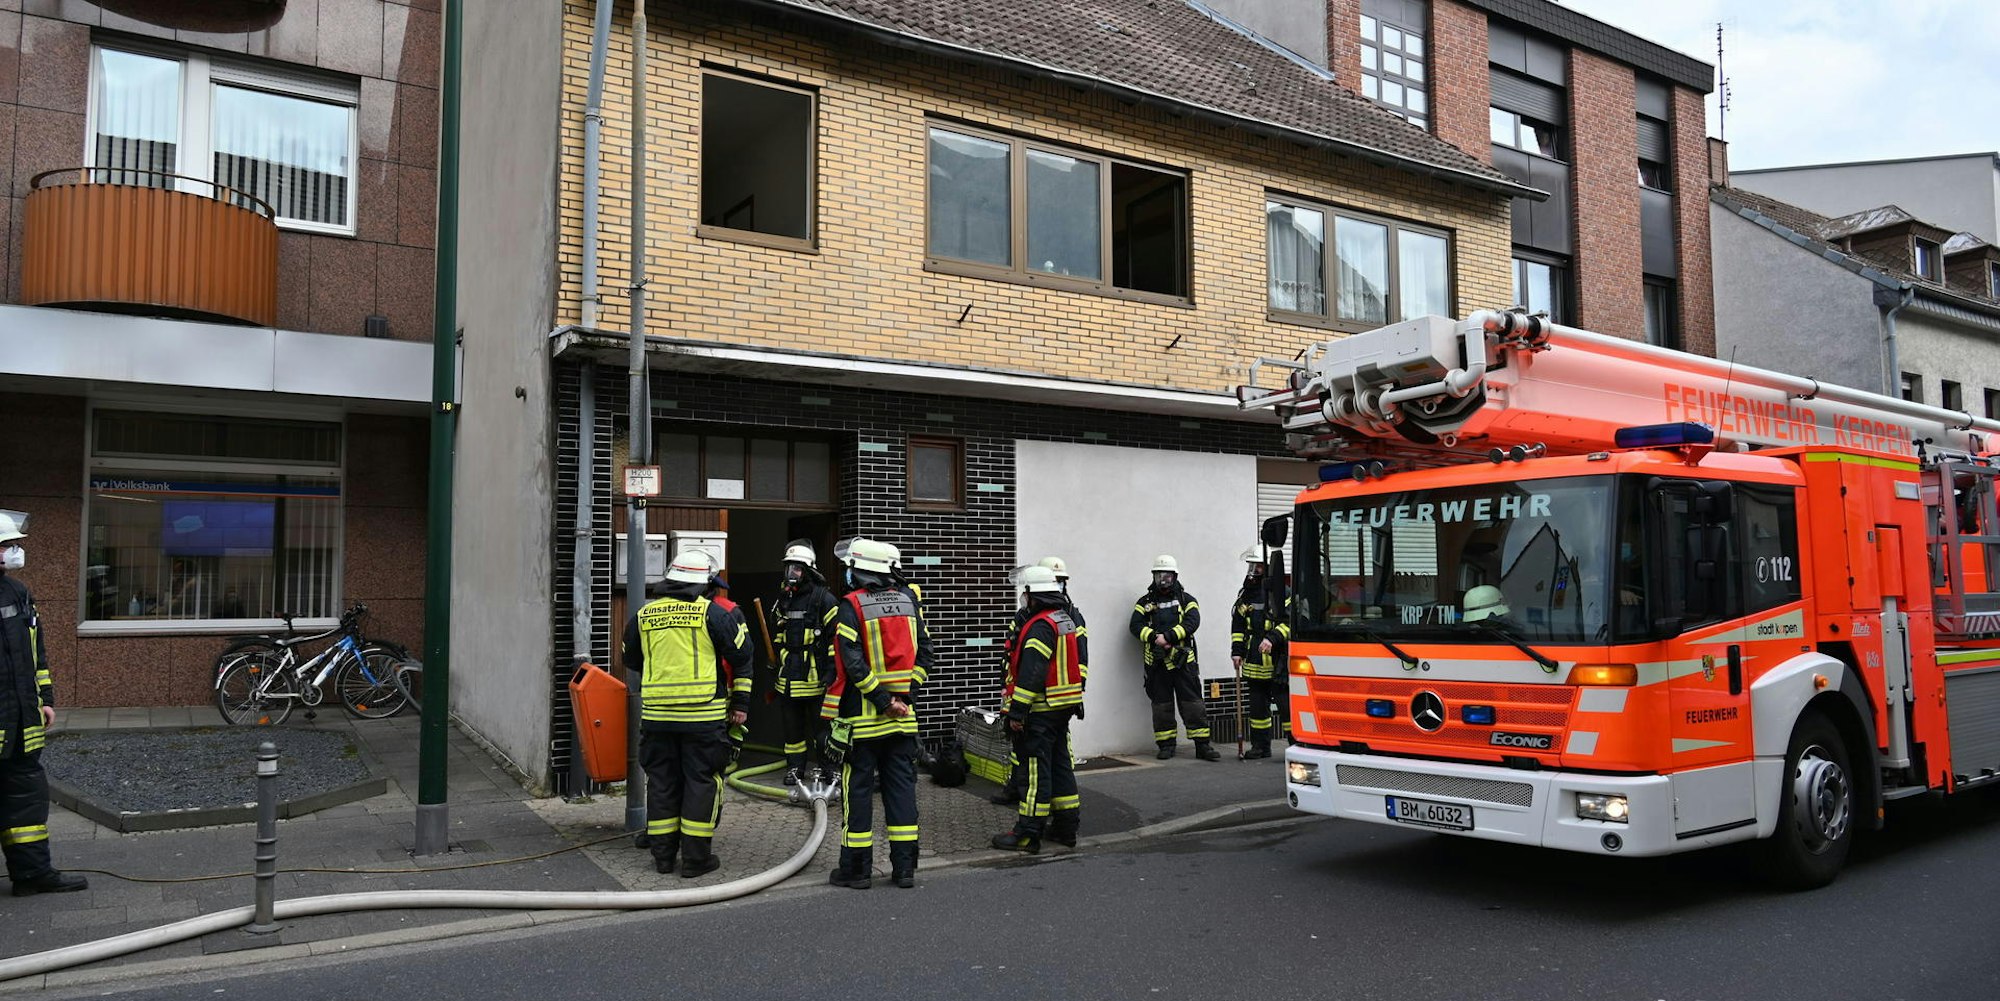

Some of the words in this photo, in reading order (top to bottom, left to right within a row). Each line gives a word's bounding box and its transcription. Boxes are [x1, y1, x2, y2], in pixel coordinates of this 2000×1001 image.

[441, 402, 452, 411] 18
[1664, 384, 1817, 443] FEUERWEHR
[1833, 413, 1912, 457] KERPEN
[113, 480, 171, 491] Volksbank
[638, 499, 647, 507] 17
[1330, 494, 1552, 529] FEUERWEHR
[1770, 555, 1793, 582] 112
[643, 603, 702, 615] Einsatzleiter
[1401, 606, 1423, 625] KRP
[1438, 605, 1456, 624] TM
[651, 620, 691, 628] Kerpen
[1757, 623, 1774, 635] stadt
[1685, 706, 1738, 725] FEUERWEHR
[1400, 801, 1419, 818] BM
[1428, 805, 1463, 824] 6032
